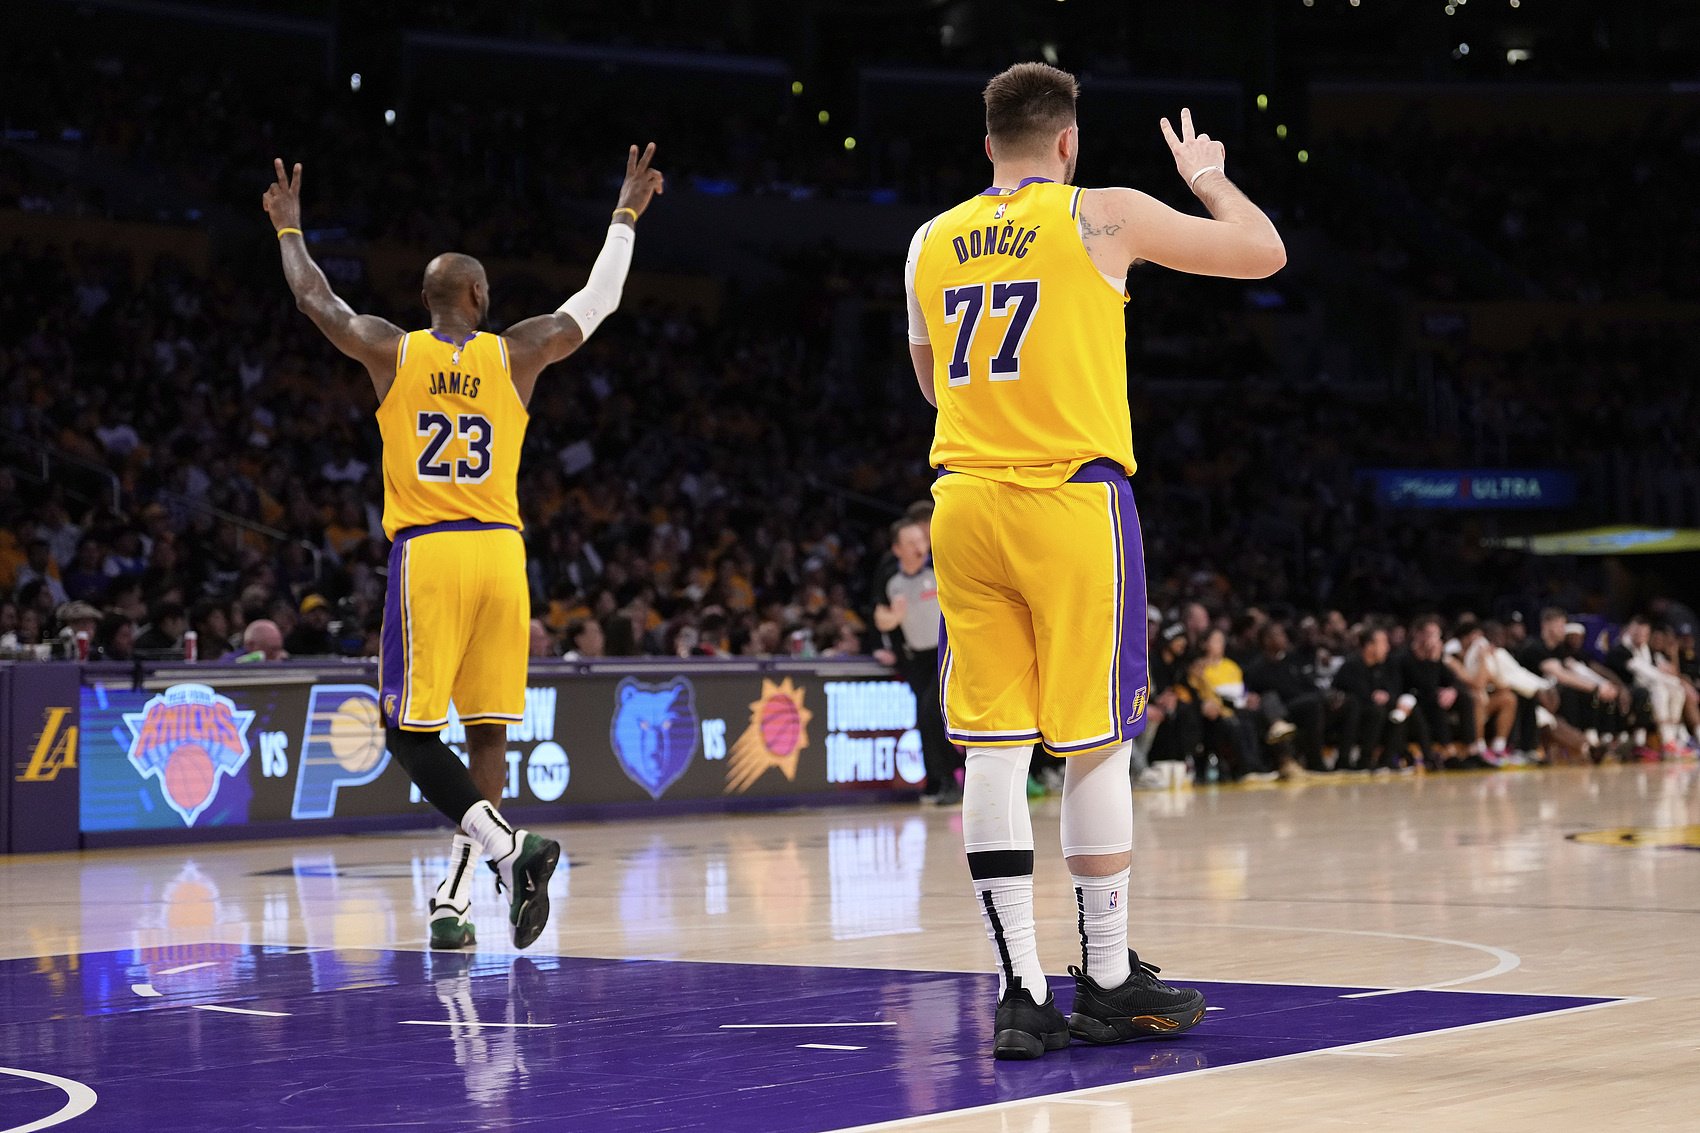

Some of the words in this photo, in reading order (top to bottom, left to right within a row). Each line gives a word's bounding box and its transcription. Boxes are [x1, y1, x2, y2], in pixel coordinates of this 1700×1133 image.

[952, 219, 1041, 265] DONČIĆ
[942, 278, 1041, 388] 77
[428, 371, 481, 399] JAMES
[415, 410, 494, 485] 23
[1471, 477, 1543, 500] ULTRA
[134, 701, 244, 758] KNICKS
[701, 718, 727, 761] VS
[259, 730, 289, 778] VS
